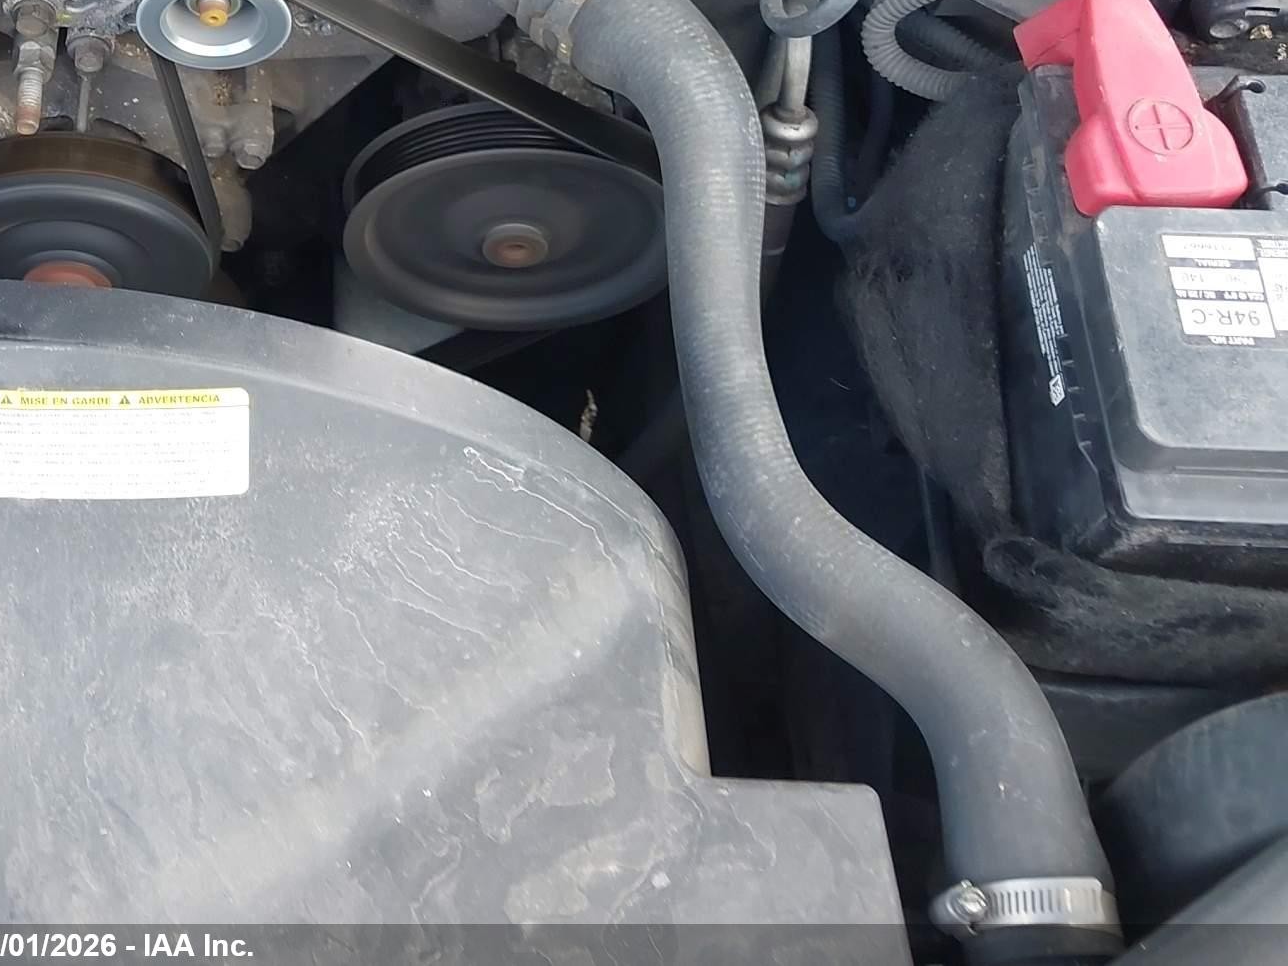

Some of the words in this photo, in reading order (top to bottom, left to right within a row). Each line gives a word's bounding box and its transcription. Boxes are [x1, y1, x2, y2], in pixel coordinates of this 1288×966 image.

[1191, 307, 1261, 327] 94R-C
[20, 395, 48, 406] MISE
[53, 396, 68, 406] EN
[138, 394, 221, 405] ADVERTENCIA
